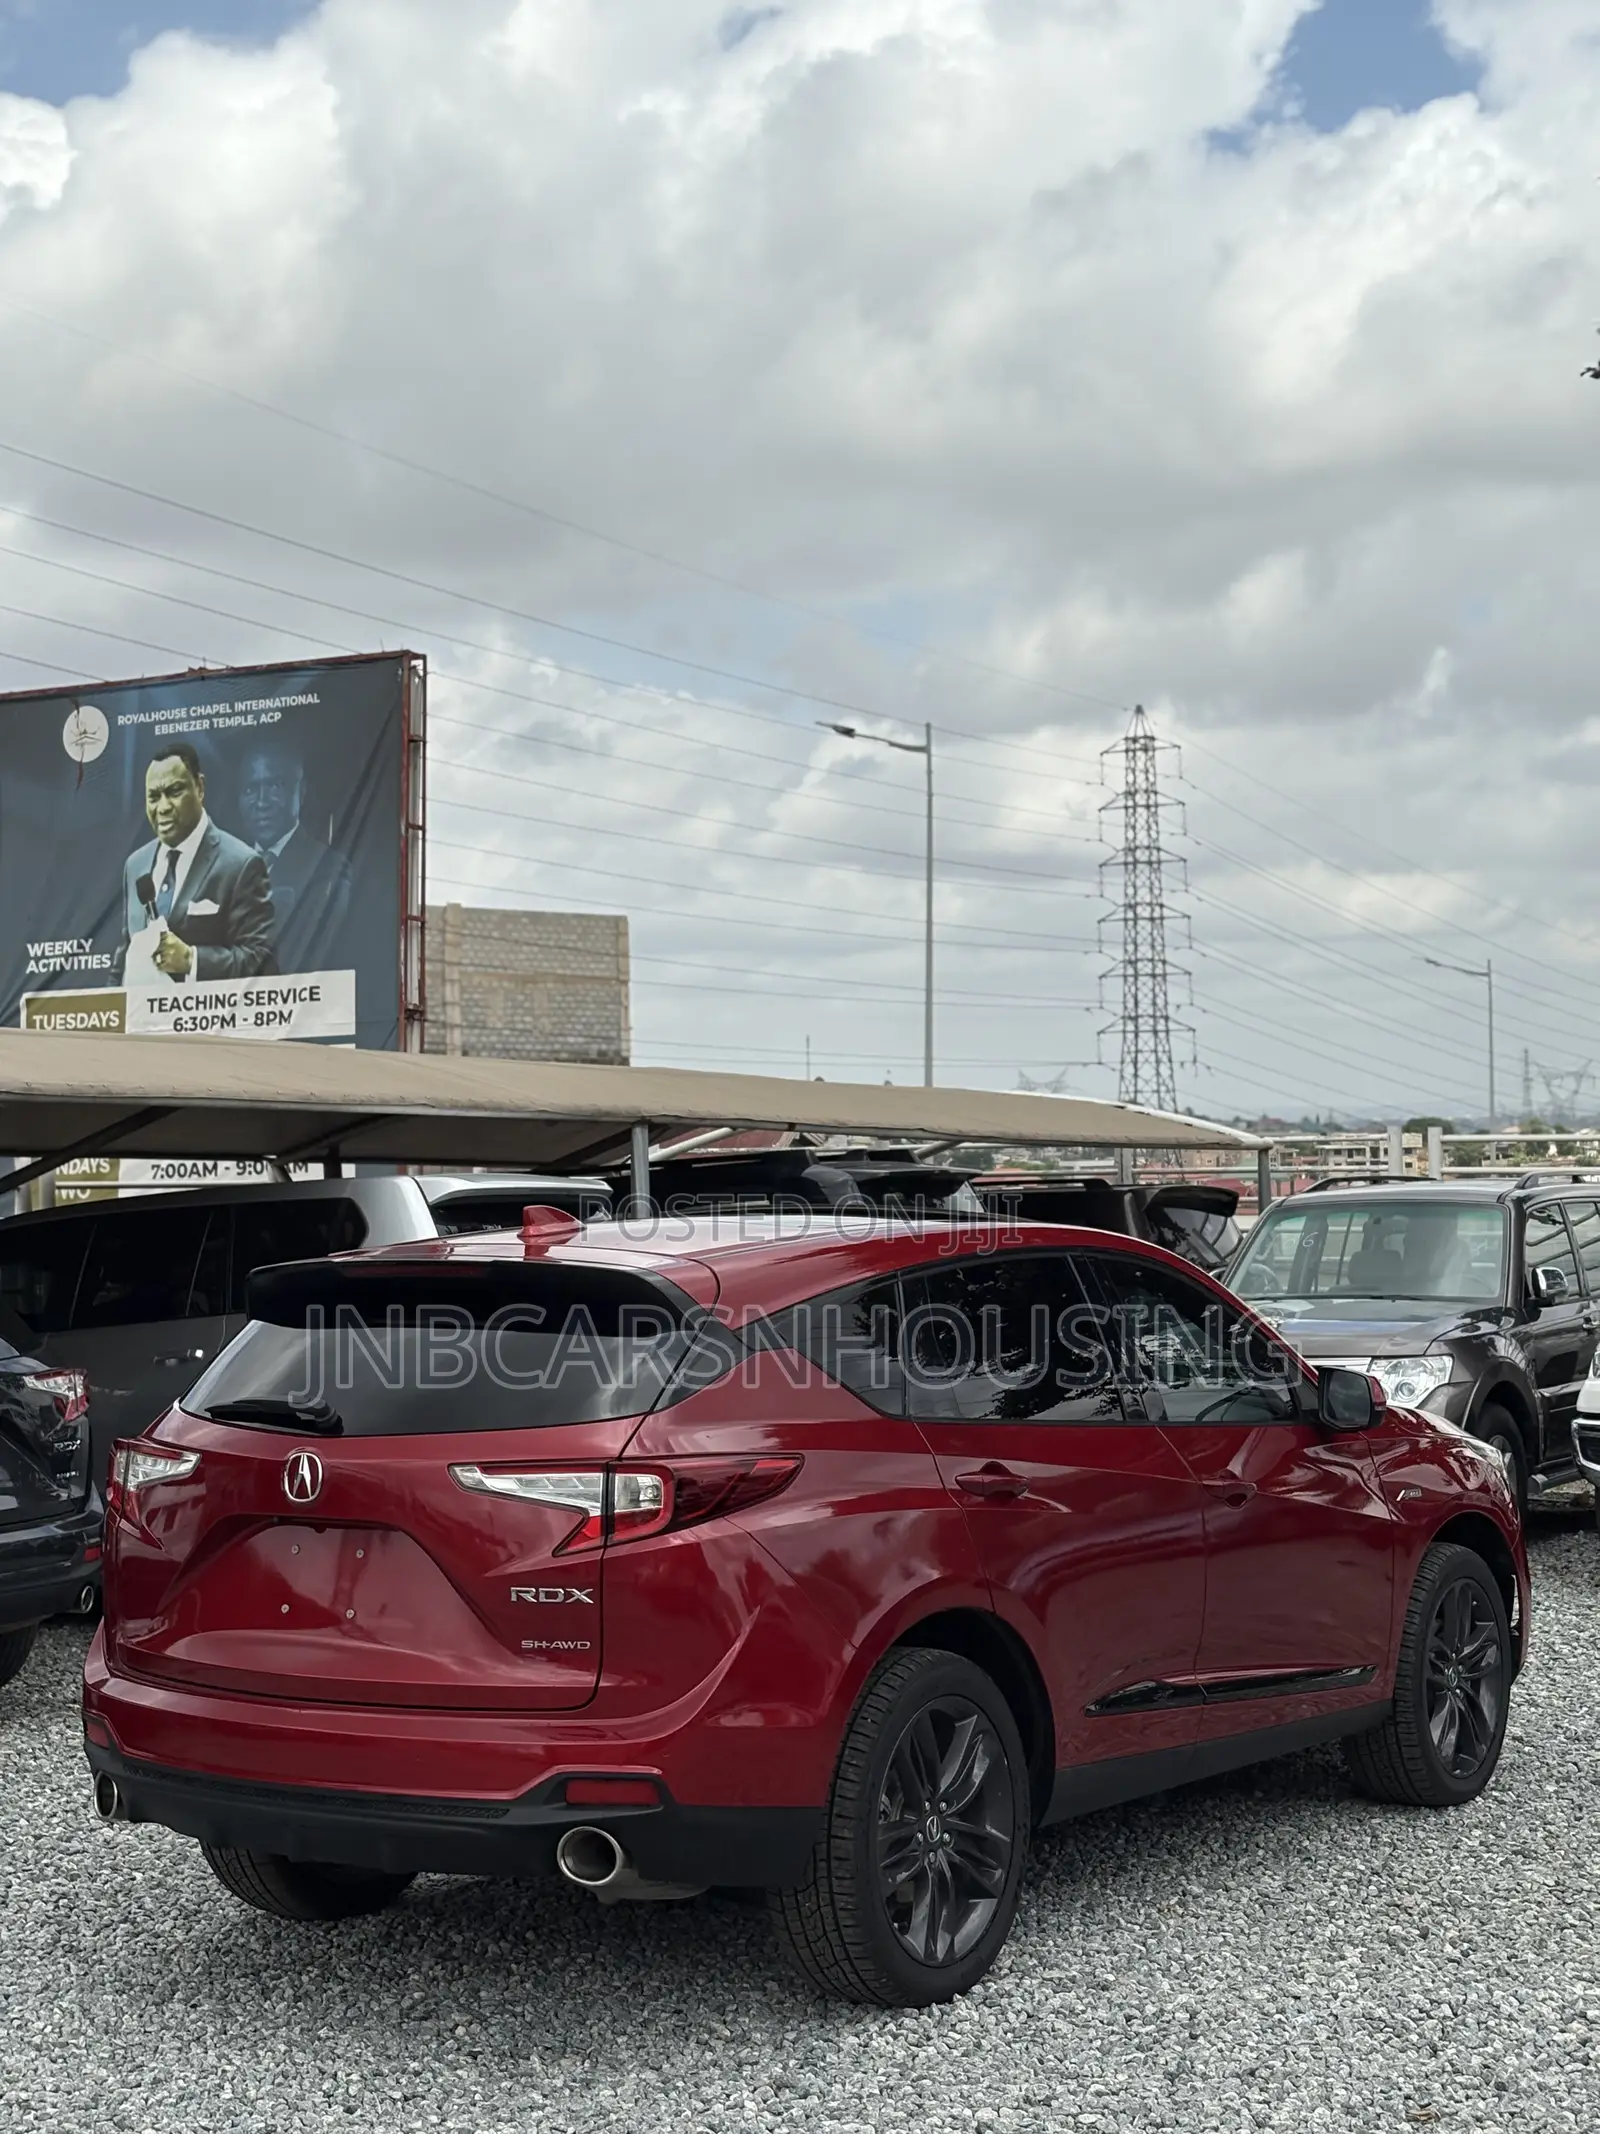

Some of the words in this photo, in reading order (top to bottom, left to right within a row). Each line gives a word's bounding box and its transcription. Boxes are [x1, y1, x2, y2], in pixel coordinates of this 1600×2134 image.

[117, 708, 187, 726] ROYALHOUSE
[189, 702, 232, 717] CHAPEL
[234, 693, 320, 713] INTERNATIONAL
[154, 719, 210, 735] EBENEZER
[212, 714, 257, 728] TEMPLE,
[259, 711, 282, 723] ACP
[26, 938, 93, 957] WEEKLY
[25, 953, 112, 974] ACTIVITIES
[147, 993, 238, 1013] TEACHING
[243, 986, 321, 1007] SERVICE
[32, 1010, 120, 1031] TUESDAYS
[173, 1013, 236, 1032] 6:30PM
[253, 1009, 293, 1026] 8PM
[151, 1161, 218, 1180] 7:00AM
[510, 1587, 594, 1604] RDX
[521, 1640, 591, 1650] SH-AWD
